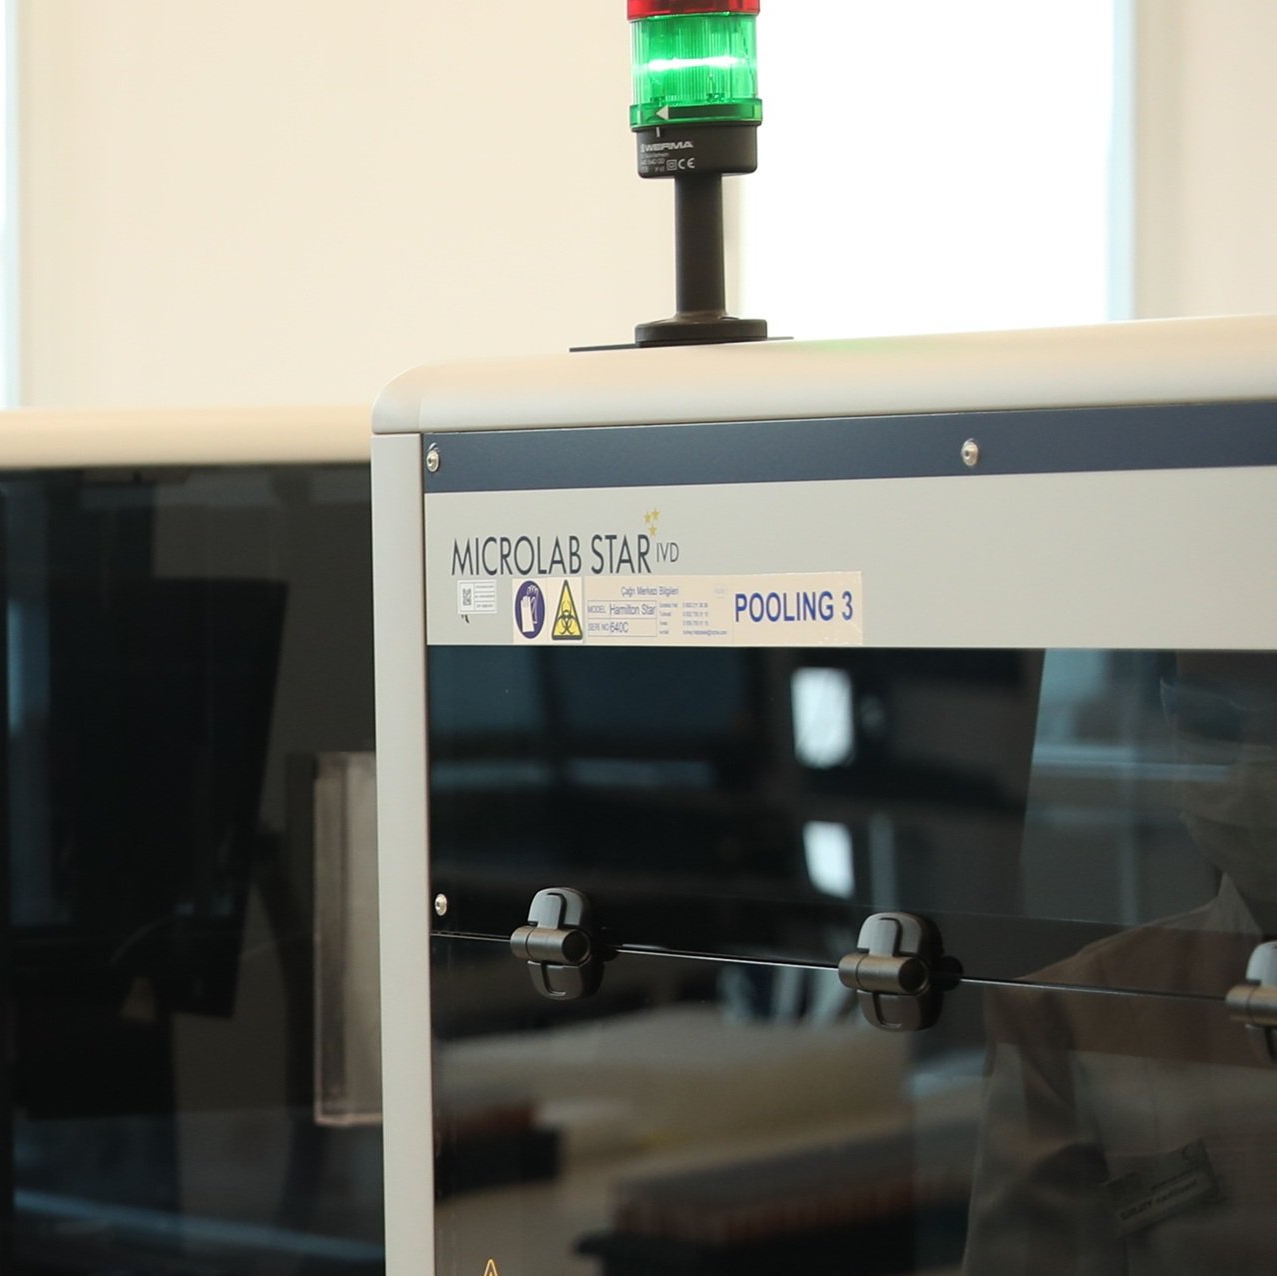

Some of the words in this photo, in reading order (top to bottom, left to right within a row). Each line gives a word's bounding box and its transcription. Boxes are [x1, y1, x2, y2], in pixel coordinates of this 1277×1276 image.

[646, 141, 694, 152] WERMA
[451, 535, 582, 576] MICROLAB
[590, 533, 653, 575] STAR
[656, 541, 680, 563] IVD
[610, 604, 640, 615] Hamilton
[641, 603, 656, 615] Star
[734, 590, 835, 623] POOLING
[842, 590, 854, 621] 3
